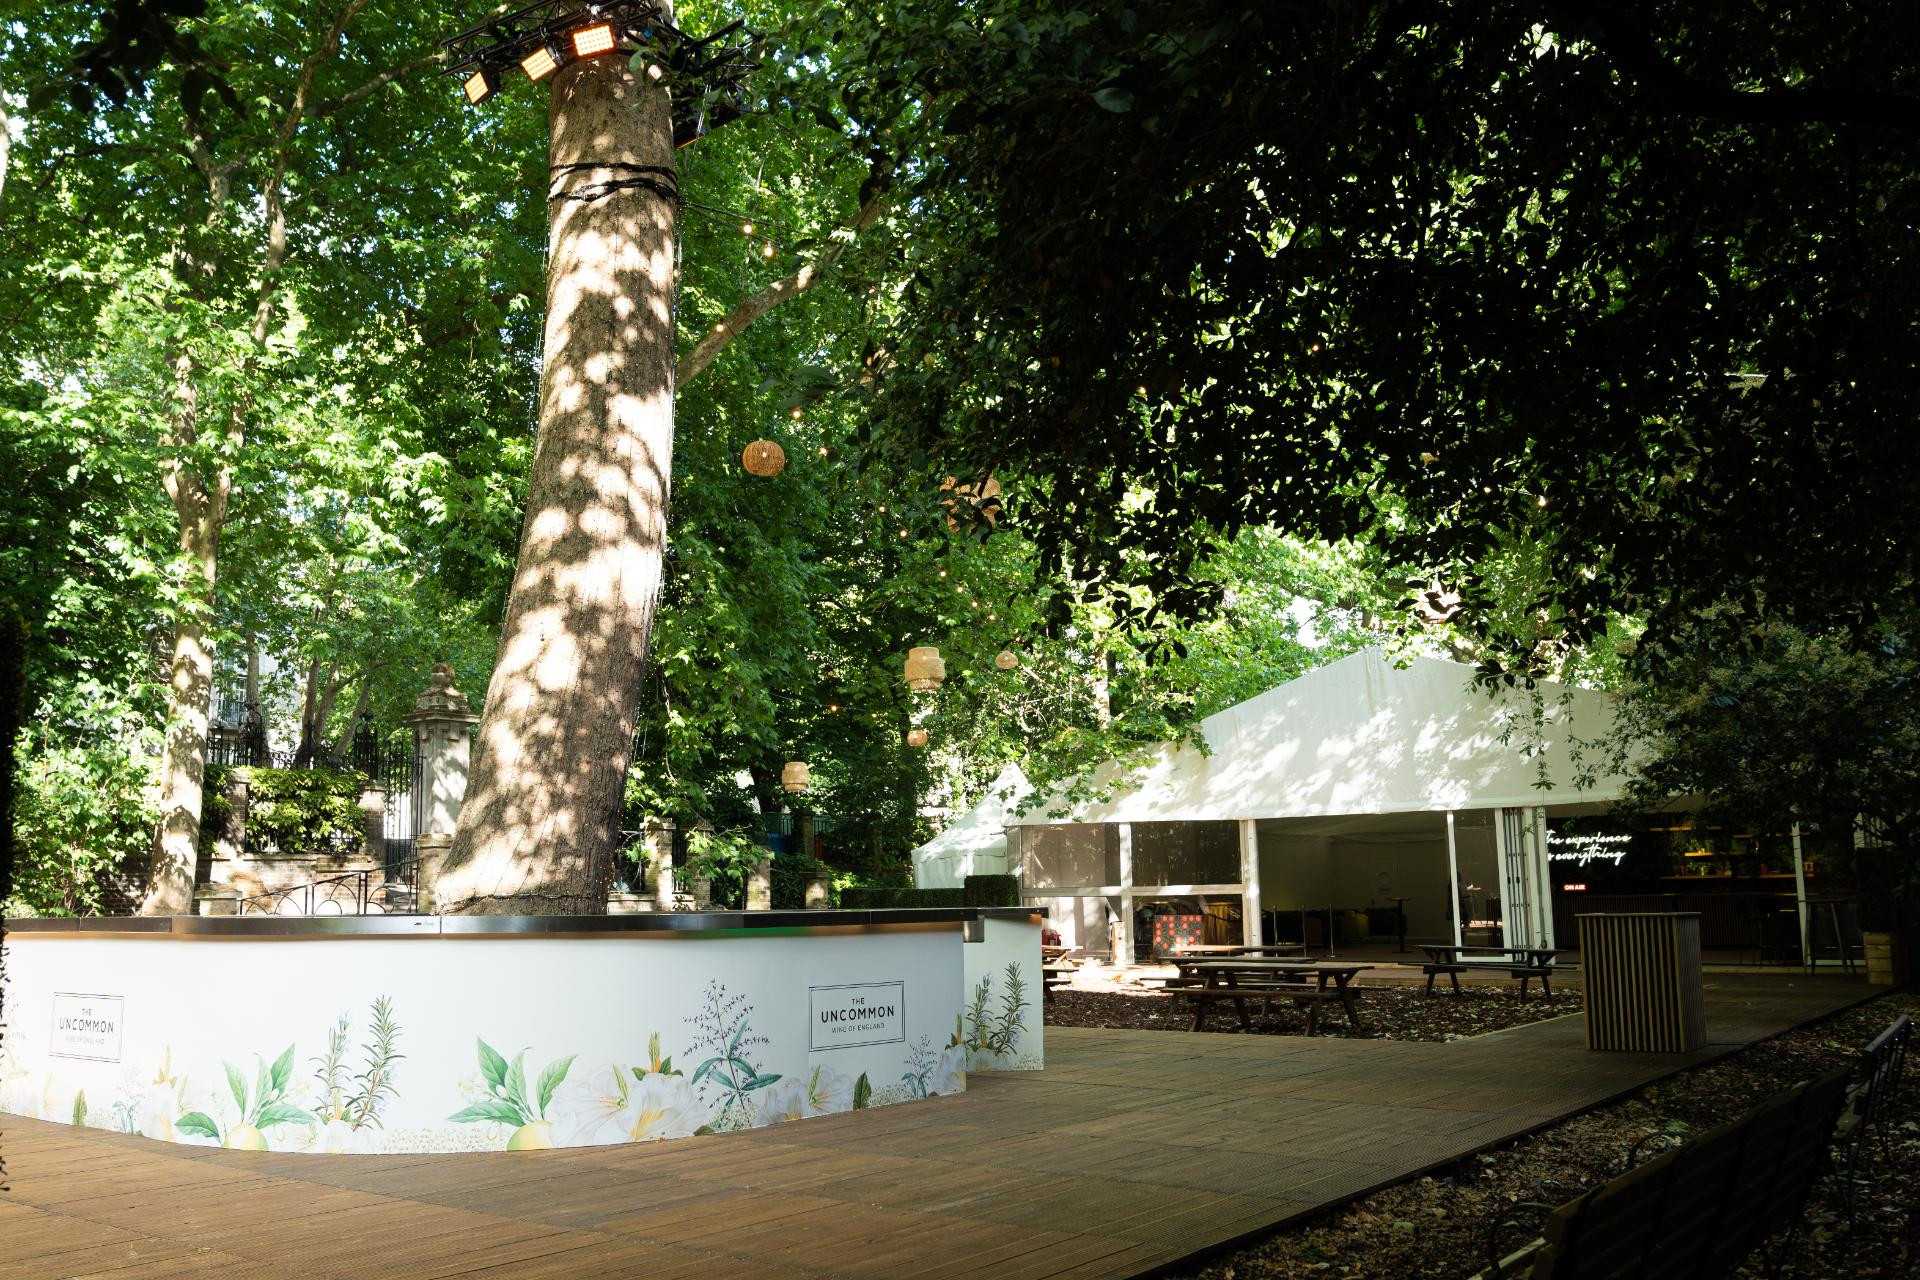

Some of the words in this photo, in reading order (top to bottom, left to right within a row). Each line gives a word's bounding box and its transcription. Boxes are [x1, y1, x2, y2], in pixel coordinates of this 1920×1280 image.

[1565, 831, 1632, 850] experience
[1555, 844, 1627, 867] everything
[851, 997, 865, 1005] THE
[821, 1006, 895, 1023] UNCOMMON
[59, 1017, 114, 1033] UNCOMMON
